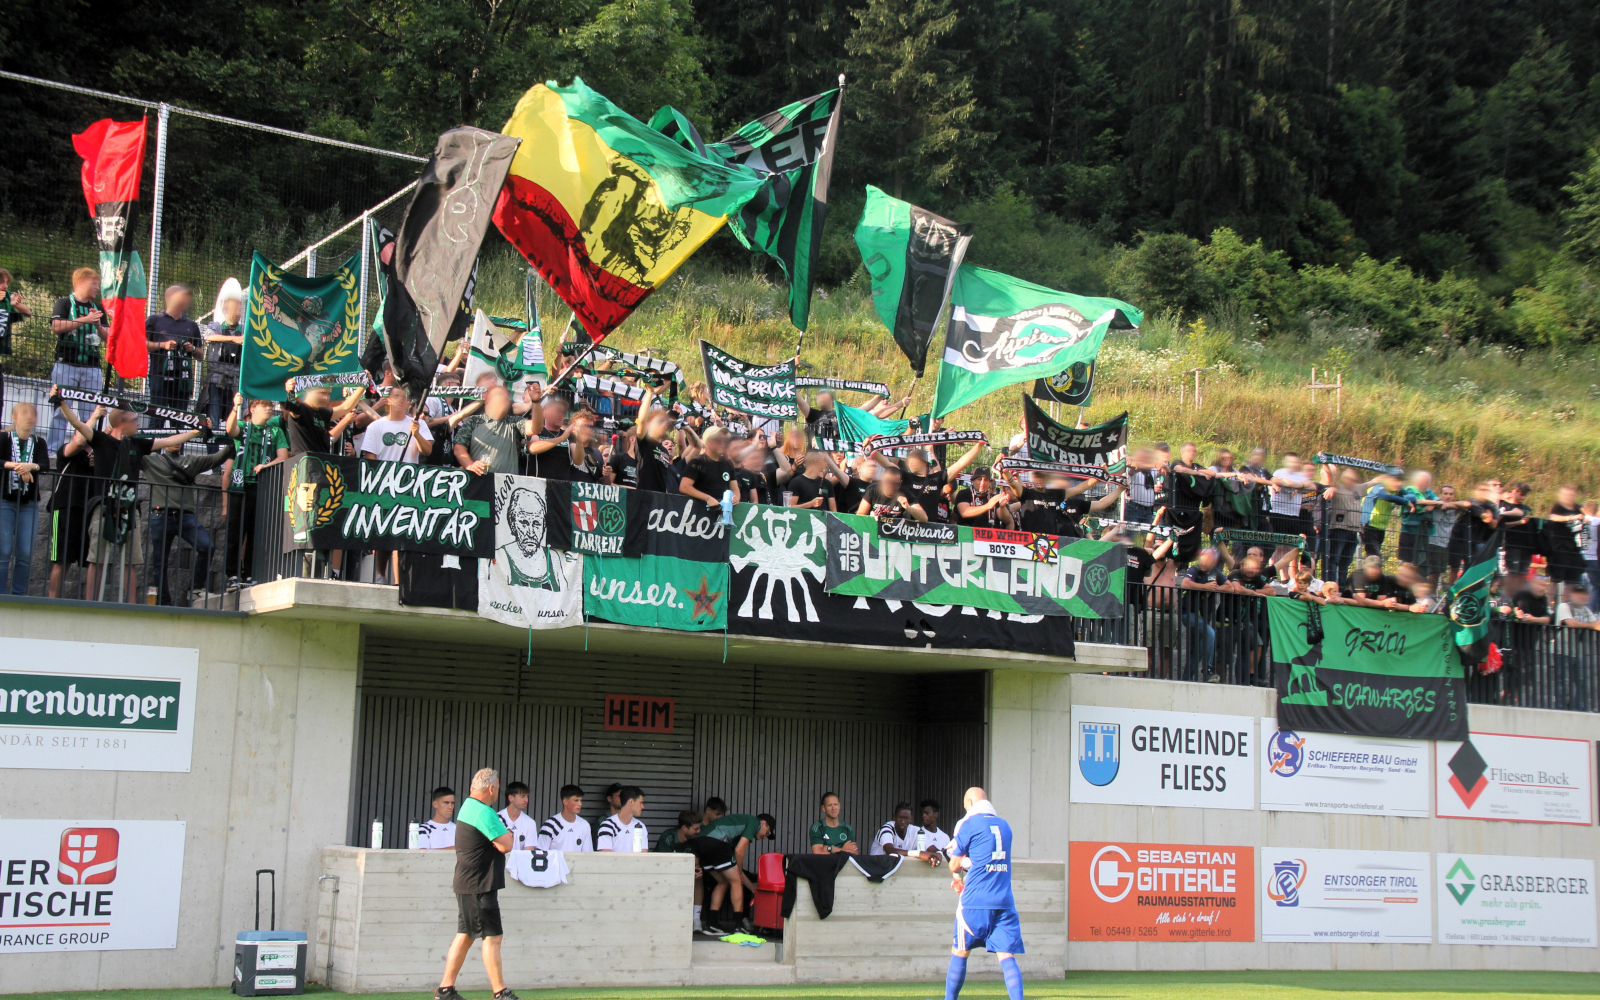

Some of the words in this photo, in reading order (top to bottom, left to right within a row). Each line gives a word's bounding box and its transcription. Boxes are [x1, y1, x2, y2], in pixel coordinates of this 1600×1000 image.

[871, 436, 900, 449] RED
[902, 432, 945, 443] WHITE
[948, 430, 982, 440] BOYS
[1047, 426, 1103, 448] SZENE
[361, 461, 468, 507] WACKER
[577, 482, 620, 503] SEXION
[343, 503, 478, 548] INVENTAR
[648, 499, 724, 539] acker
[881, 518, 955, 540] Aspirante
[974, 528, 993, 540] RED
[997, 531, 1029, 543] WHITE
[1236, 531, 1274, 541] LEGENDE
[1278, 534, 1298, 544] LEBT
[573, 530, 625, 554] TARRENZ
[989, 544, 1016, 555] BOYS
[863, 532, 1083, 599] UNTERLAND
[590, 575, 684, 609] unser.
[490, 600, 523, 615] wacker
[538, 608, 568, 618] unser.
[1344, 624, 1406, 657] GRÜN
[1332, 683, 1436, 718] SCHWARZES
[608, 699, 670, 728] HEIM
[52, 736, 89, 748] SEIT
[95, 738, 128, 749] 1881
[1131, 725, 1248, 758] GEMEINDE
[1309, 750, 1370, 764] SCHIEFERER
[1372, 754, 1391, 765] BAU
[1394, 756, 1418, 766] GmbH
[1161, 763, 1227, 792] FLIESS
[1490, 768, 1534, 783] Fliesen
[1538, 771, 1570, 785] Bock
[1503, 786, 1523, 794] Fliesen
[1305, 801, 1384, 810] www.transporte-schieferer.at
[990, 825, 1006, 860] 1
[530, 850, 548, 872] 8
[1137, 849, 1236, 865] SEBASTIAN
[0, 859, 50, 886] ER
[1137, 867, 1236, 893] GITTERLE
[1324, 875, 1386, 887] ENTSORGER
[1389, 876, 1418, 887] TIROL
[1481, 874, 1589, 894] GRASBERGER
[1137, 895, 1236, 908] RAUMAUSSTATTUNG
[1481, 897, 1502, 907] mehr
[1505, 899, 1517, 908] als
[1519, 900, 1542, 911] grün.
[1156, 912, 1170, 924] Alle
[1461, 917, 1526, 927] www.grasberger.at
[59, 932, 110, 945] GROUP
[1090, 926, 1104, 936] Tel.
[1106, 927, 1131, 936] 05449
[1138, 927, 1158, 936] 5265
[1168, 928, 1231, 938] www.gitterle.tirol
[1313, 930, 1380, 938] www.entsorger-tirol.at
